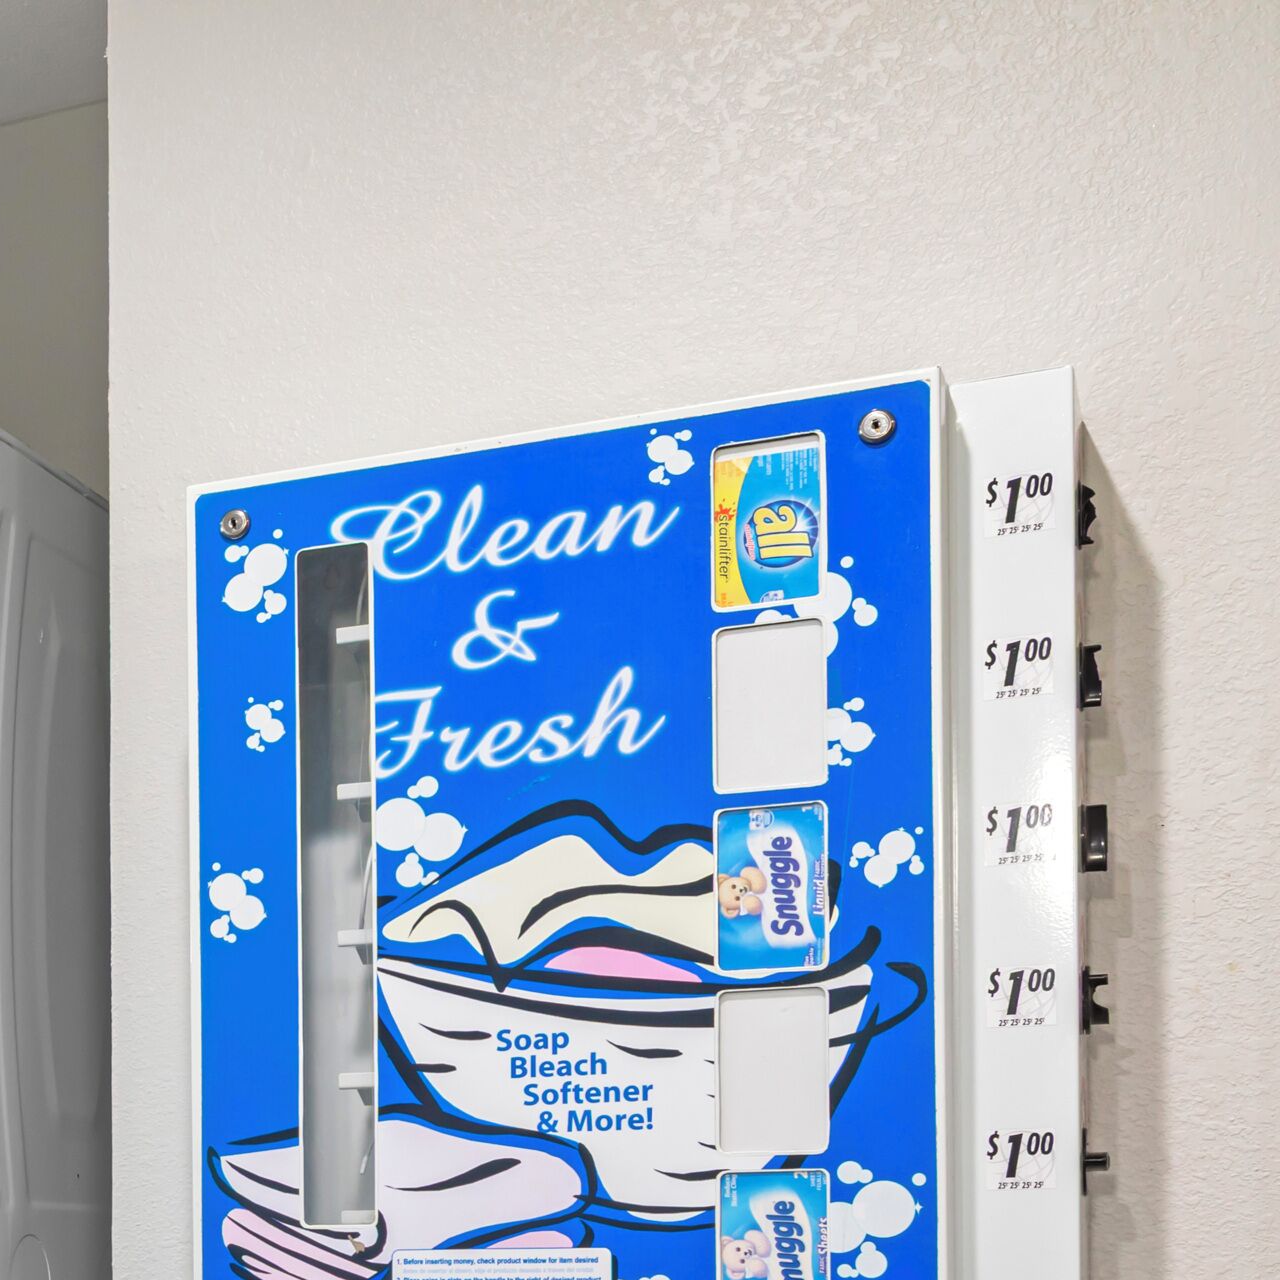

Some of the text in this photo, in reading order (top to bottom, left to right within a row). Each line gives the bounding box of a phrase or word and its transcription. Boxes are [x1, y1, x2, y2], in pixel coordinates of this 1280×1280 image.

[330, 484, 680, 580] Clean
[718, 514, 732, 578] stainlifter
[753, 505, 814, 559] all
[451, 589, 560, 670] &
[375, 665, 666, 780] Fresh
[763, 836, 804, 937] Snuggle
[496, 1029, 570, 1055] Soap
[510, 1052, 607, 1078] Bleach
[523, 1081, 653, 1106] Softener
[537, 1107, 654, 1133] & More!
[425, 1258, 452, 1266] inserting
